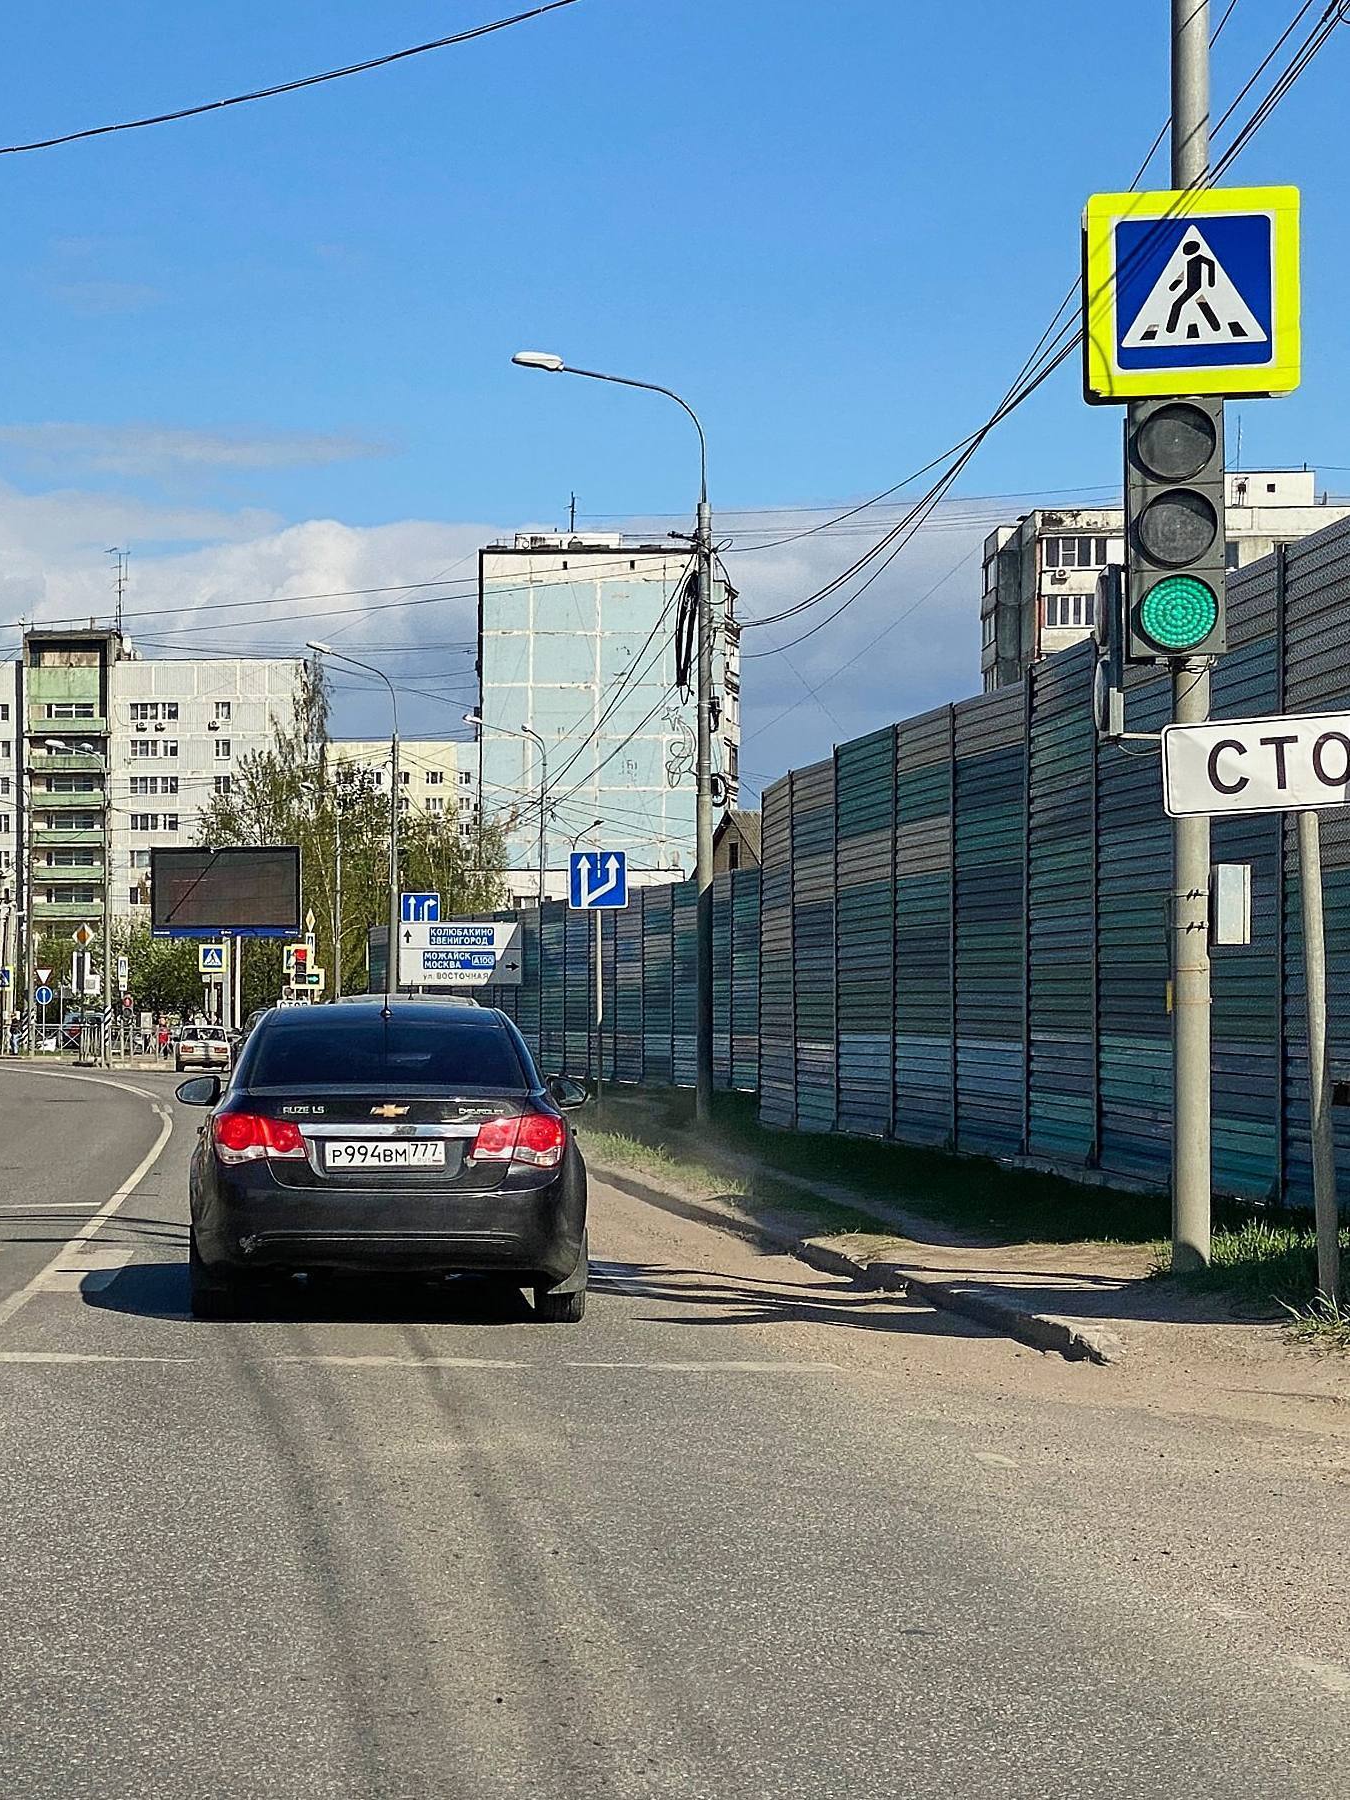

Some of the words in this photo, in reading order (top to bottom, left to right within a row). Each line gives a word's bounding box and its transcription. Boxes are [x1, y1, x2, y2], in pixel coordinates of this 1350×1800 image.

[430, 928, 493, 936] КОЛЮБАКИНО
[430, 937, 488, 945] ЗВЕНИГОРОД
[424, 952, 471, 960] МОЖАЙСК
[424, 961, 462, 969] МОСКВА
[436, 972, 490, 980] ВОСТОЧНАЯ
[312, 1105, 325, 1114] LS
[410, 1143, 439, 1158] 777
